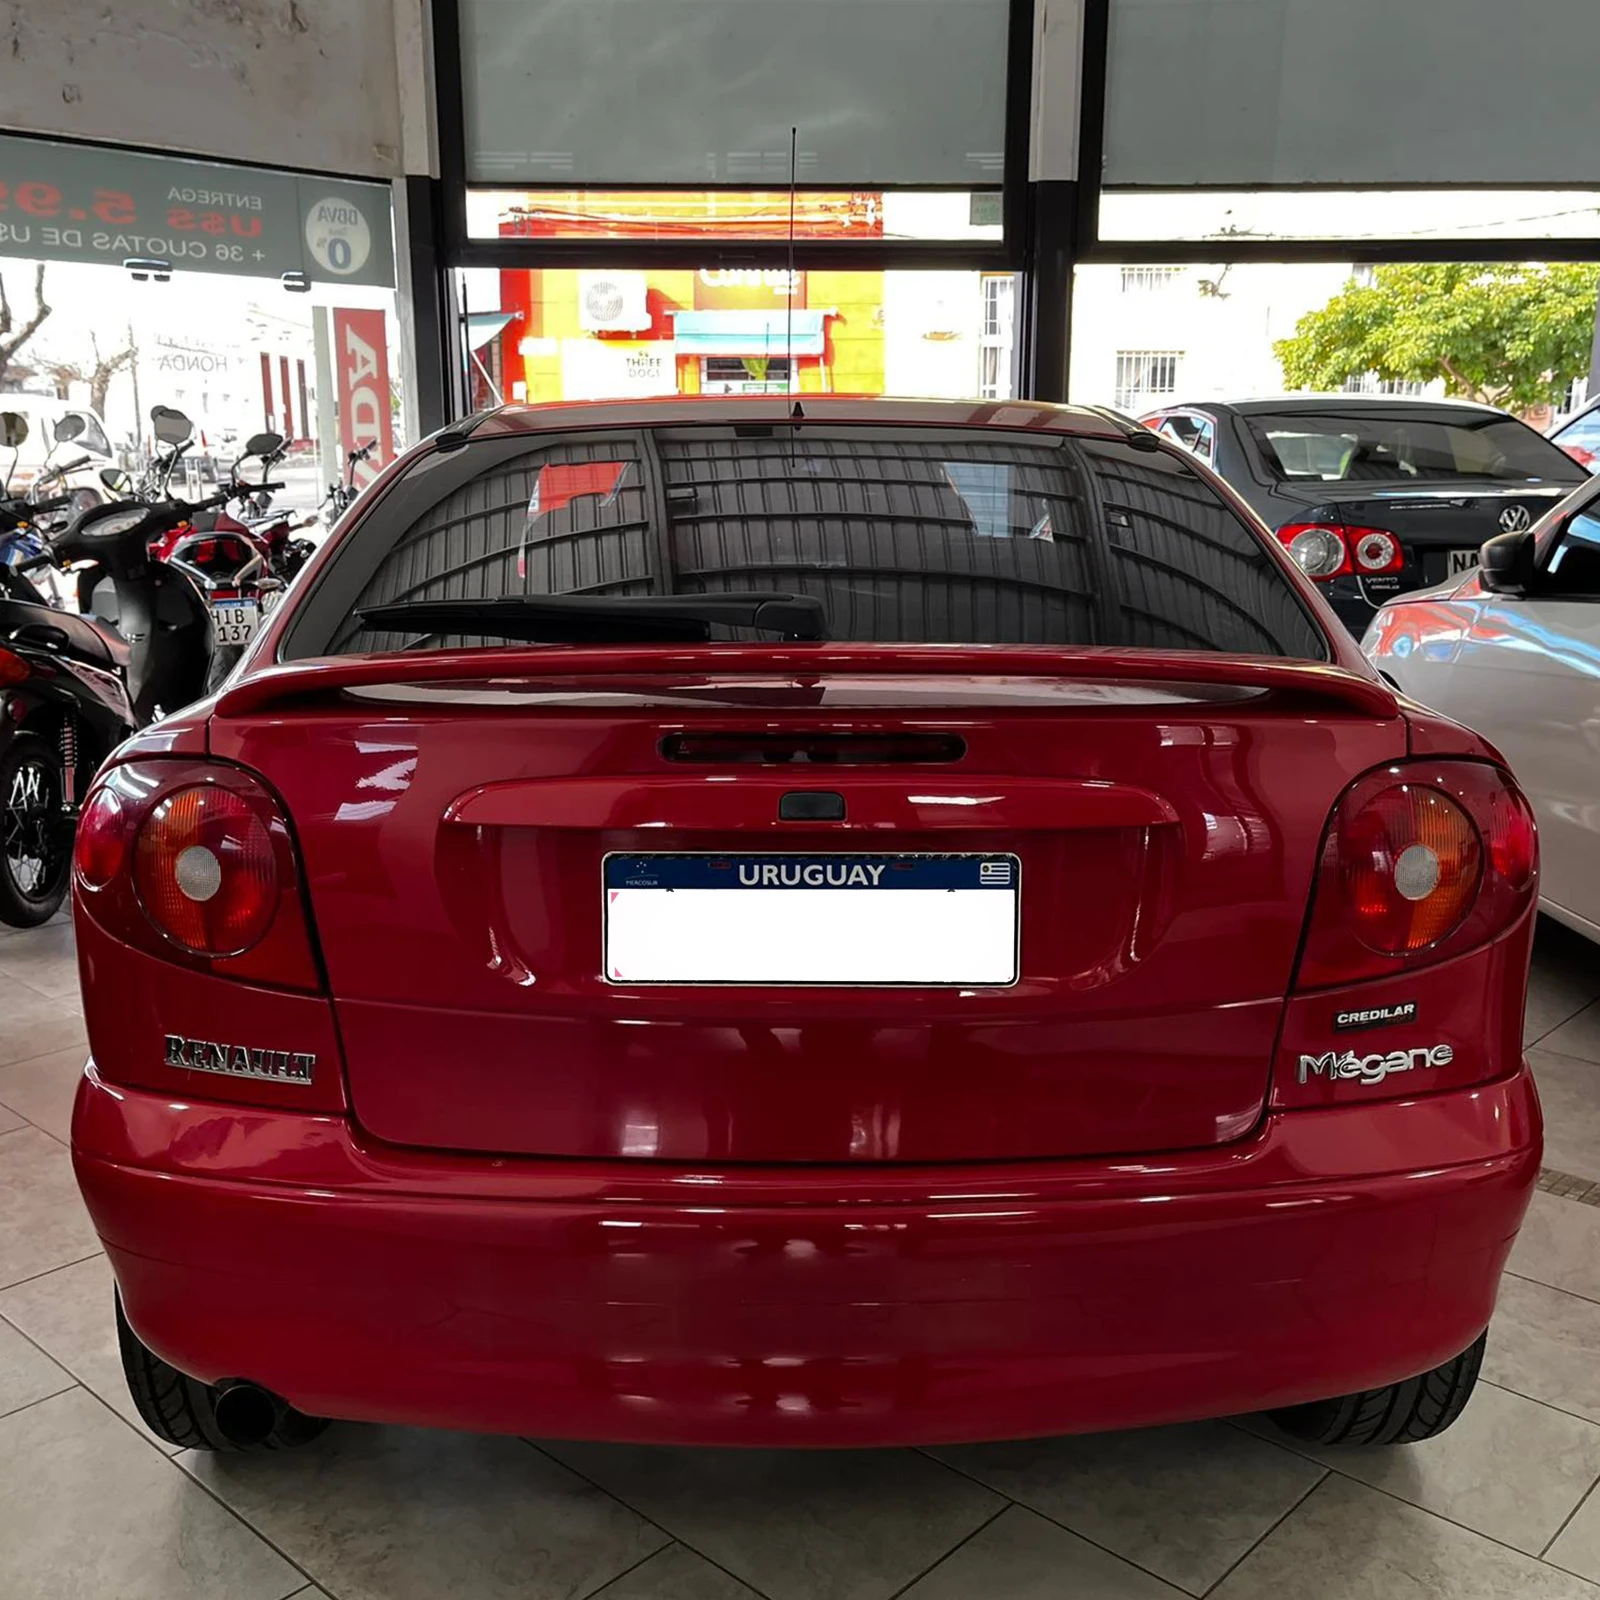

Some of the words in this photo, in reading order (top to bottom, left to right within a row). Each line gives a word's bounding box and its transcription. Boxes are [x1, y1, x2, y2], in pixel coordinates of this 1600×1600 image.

[218, 625, 252, 642] 137
[738, 864, 886, 886] URUGUAY
[1337, 1003, 1415, 1024] CREDILAR
[163, 1033, 316, 1085] RENAULT
